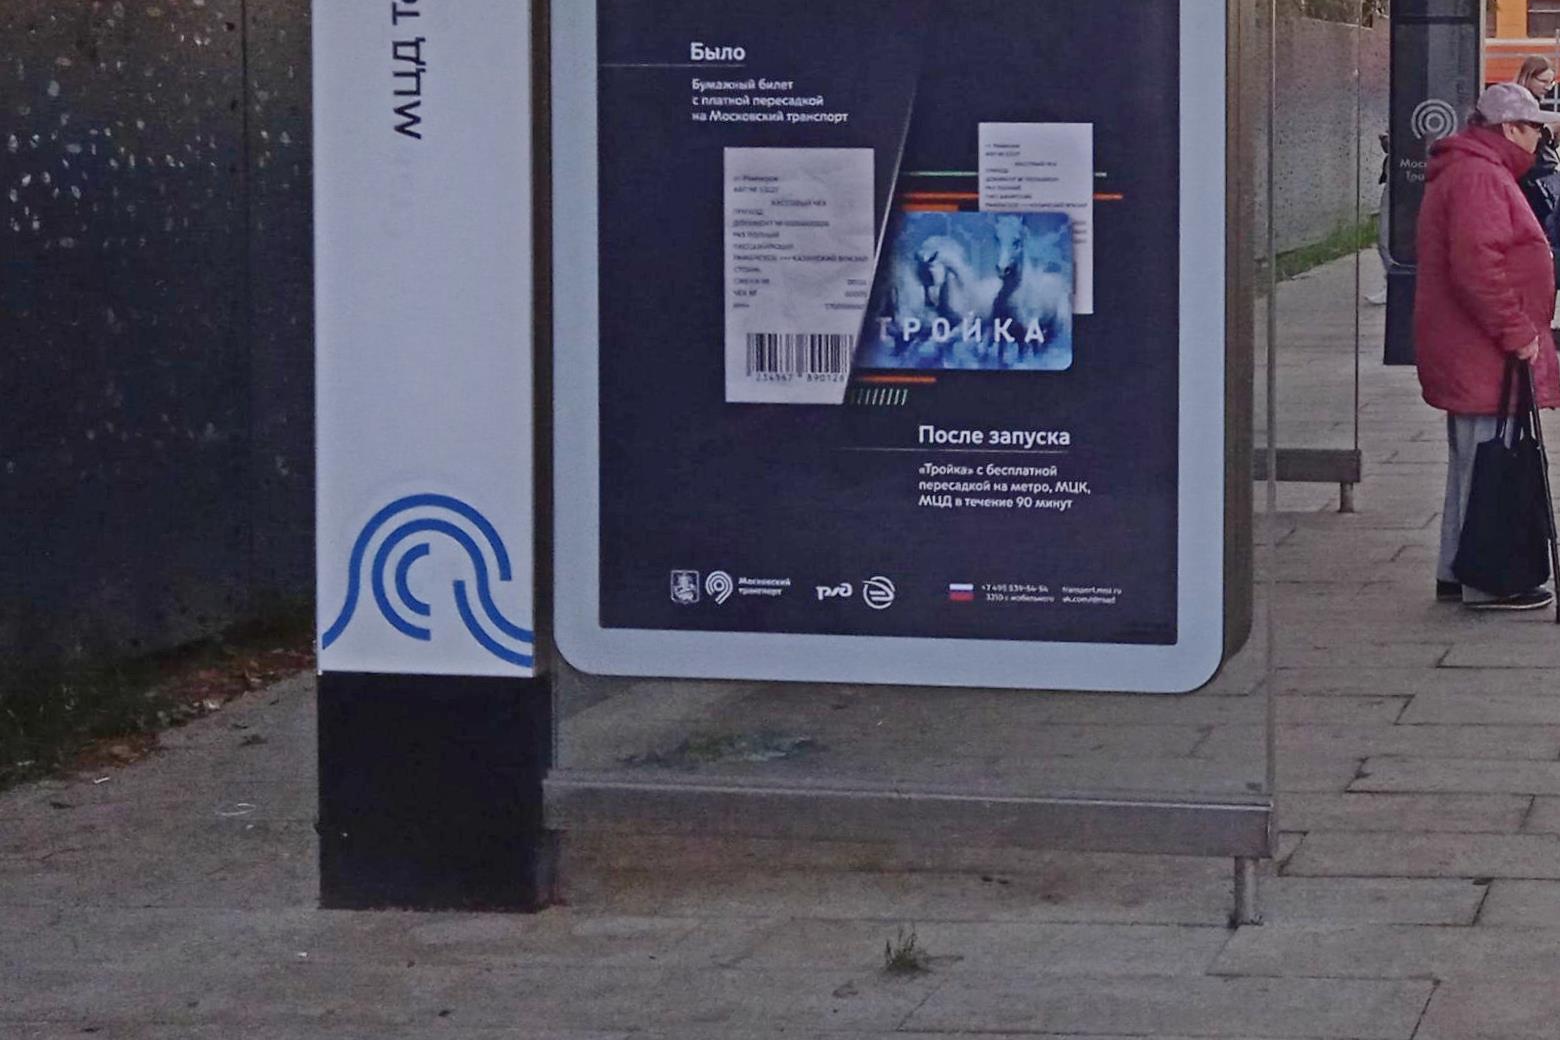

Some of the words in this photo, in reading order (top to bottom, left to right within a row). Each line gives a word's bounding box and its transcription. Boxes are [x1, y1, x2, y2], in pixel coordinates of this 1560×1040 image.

[690, 41, 746, 61] Было
[393, 36, 427, 140] МЦД
[691, 78, 756, 92] Бумажный
[758, 78, 793, 91] билет
[692, 96, 699, 106] с
[701, 95, 750, 106] платной
[752, 95, 824, 108] пересадкой
[691, 112, 707, 122] на
[708, 110, 784, 122] Московский
[786, 112, 849, 124] транспорт
[876, 311, 1045, 344] ТРОЙКА
[918, 425, 984, 445] После
[988, 430, 1071, 449] запуска
[918, 463, 974, 477] «Тройка»
[976, 466, 983, 476] с
[986, 463, 1058, 477] бесплатной
[918, 480, 991, 494] пересадкой
[993, 481, 1008, 492] на
[1010, 482, 1053, 495] метро,
[1055, 481, 1091, 495] МЦК,
[918, 495, 952, 508] МЦД
[955, 498, 962, 506] в
[964, 497, 1014, 508] течение
[1016, 496, 1032, 508] 90
[1035, 498, 1073, 511] минут
